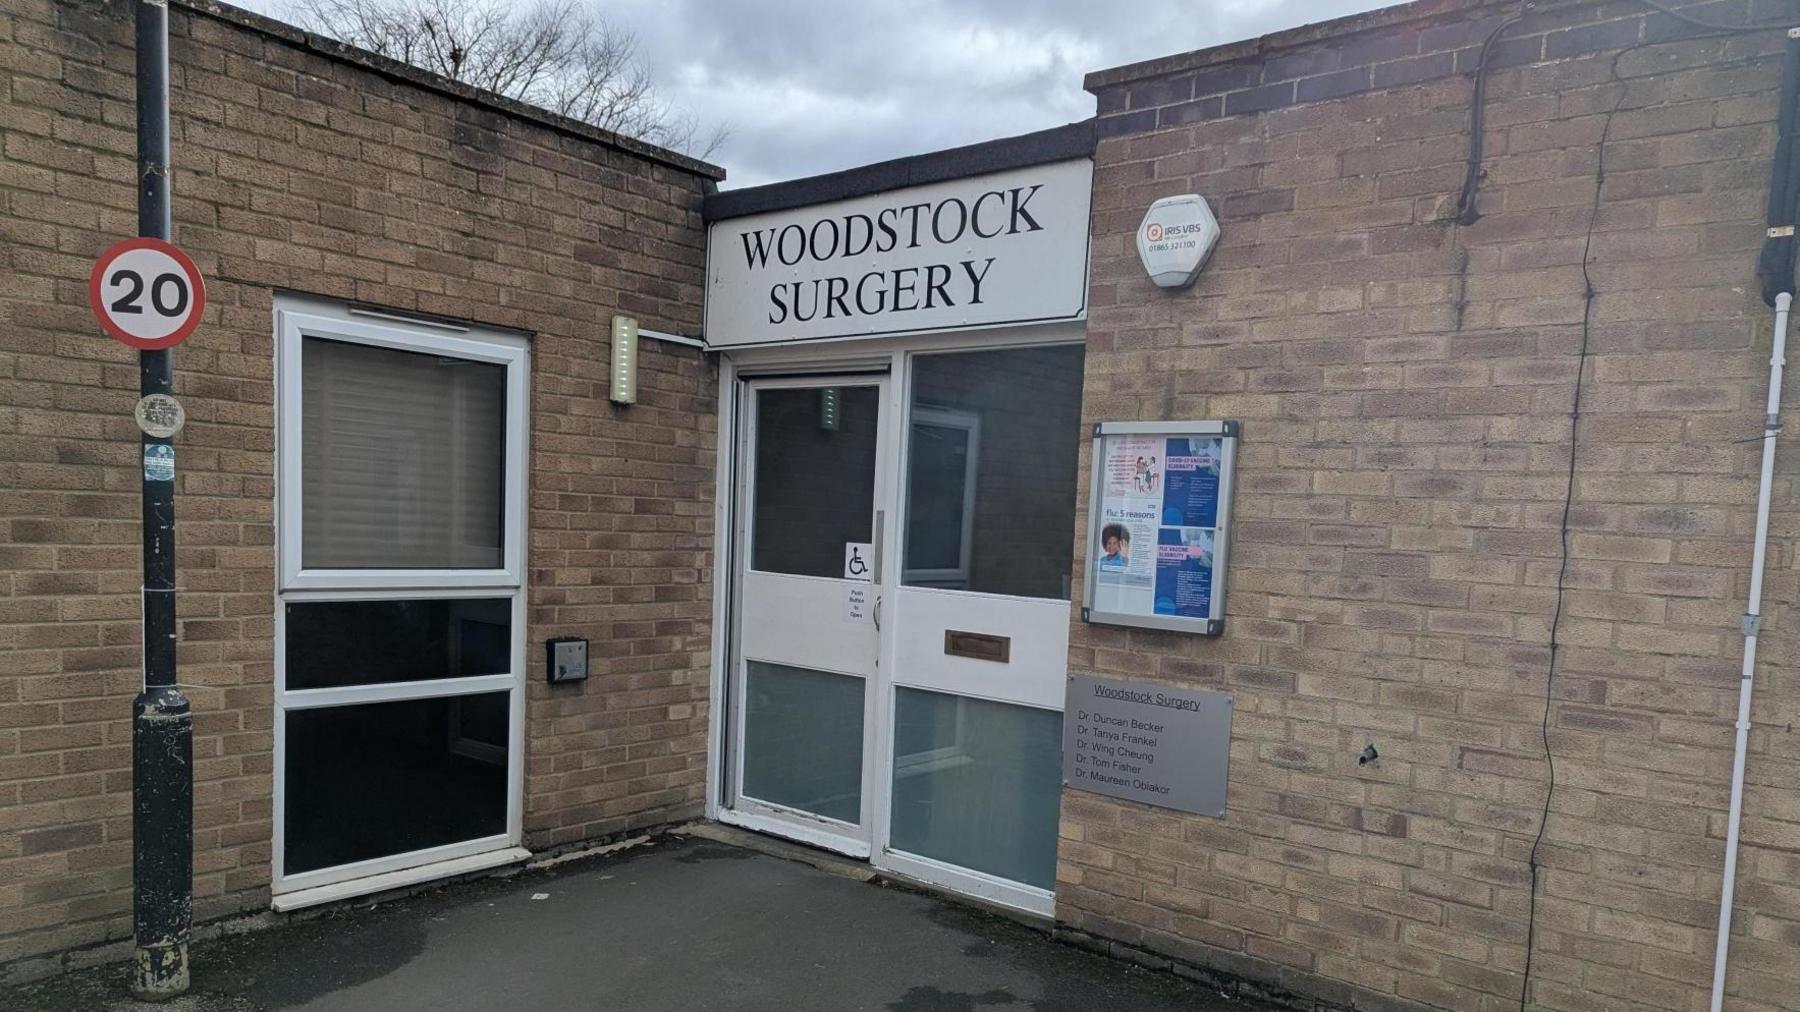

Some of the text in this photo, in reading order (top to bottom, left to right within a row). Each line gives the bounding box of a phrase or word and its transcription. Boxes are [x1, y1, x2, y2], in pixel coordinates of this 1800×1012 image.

[741, 184, 1045, 271] WOODSTOCK
[1164, 224, 1201, 236] IRIS VBS
[1149, 240, 1196, 252] 01865 321100
[110, 269, 188, 317] 20
[769, 257, 996, 325] SURGERY
[1119, 509, 1125, 518] 5
[1126, 511, 1156, 519] reasons
[850, 611, 862, 619] Open
[1094, 684, 1200, 712] Woodstock Surgery
[1093, 712, 1128, 728] Duncan
[1131, 720, 1164, 734] Becker
[1093, 728, 1120, 742] Tanya
[1122, 733, 1157, 748] Frankel
[1092, 742, 1115, 756] Wing
[1118, 746, 1154, 763] Cheung
[1092, 756, 1110, 769] Tom
[1113, 761, 1141, 775] Fisher
[1090, 771, 1131, 787] Maureen
[1133, 779, 1170, 794] Obiakor
